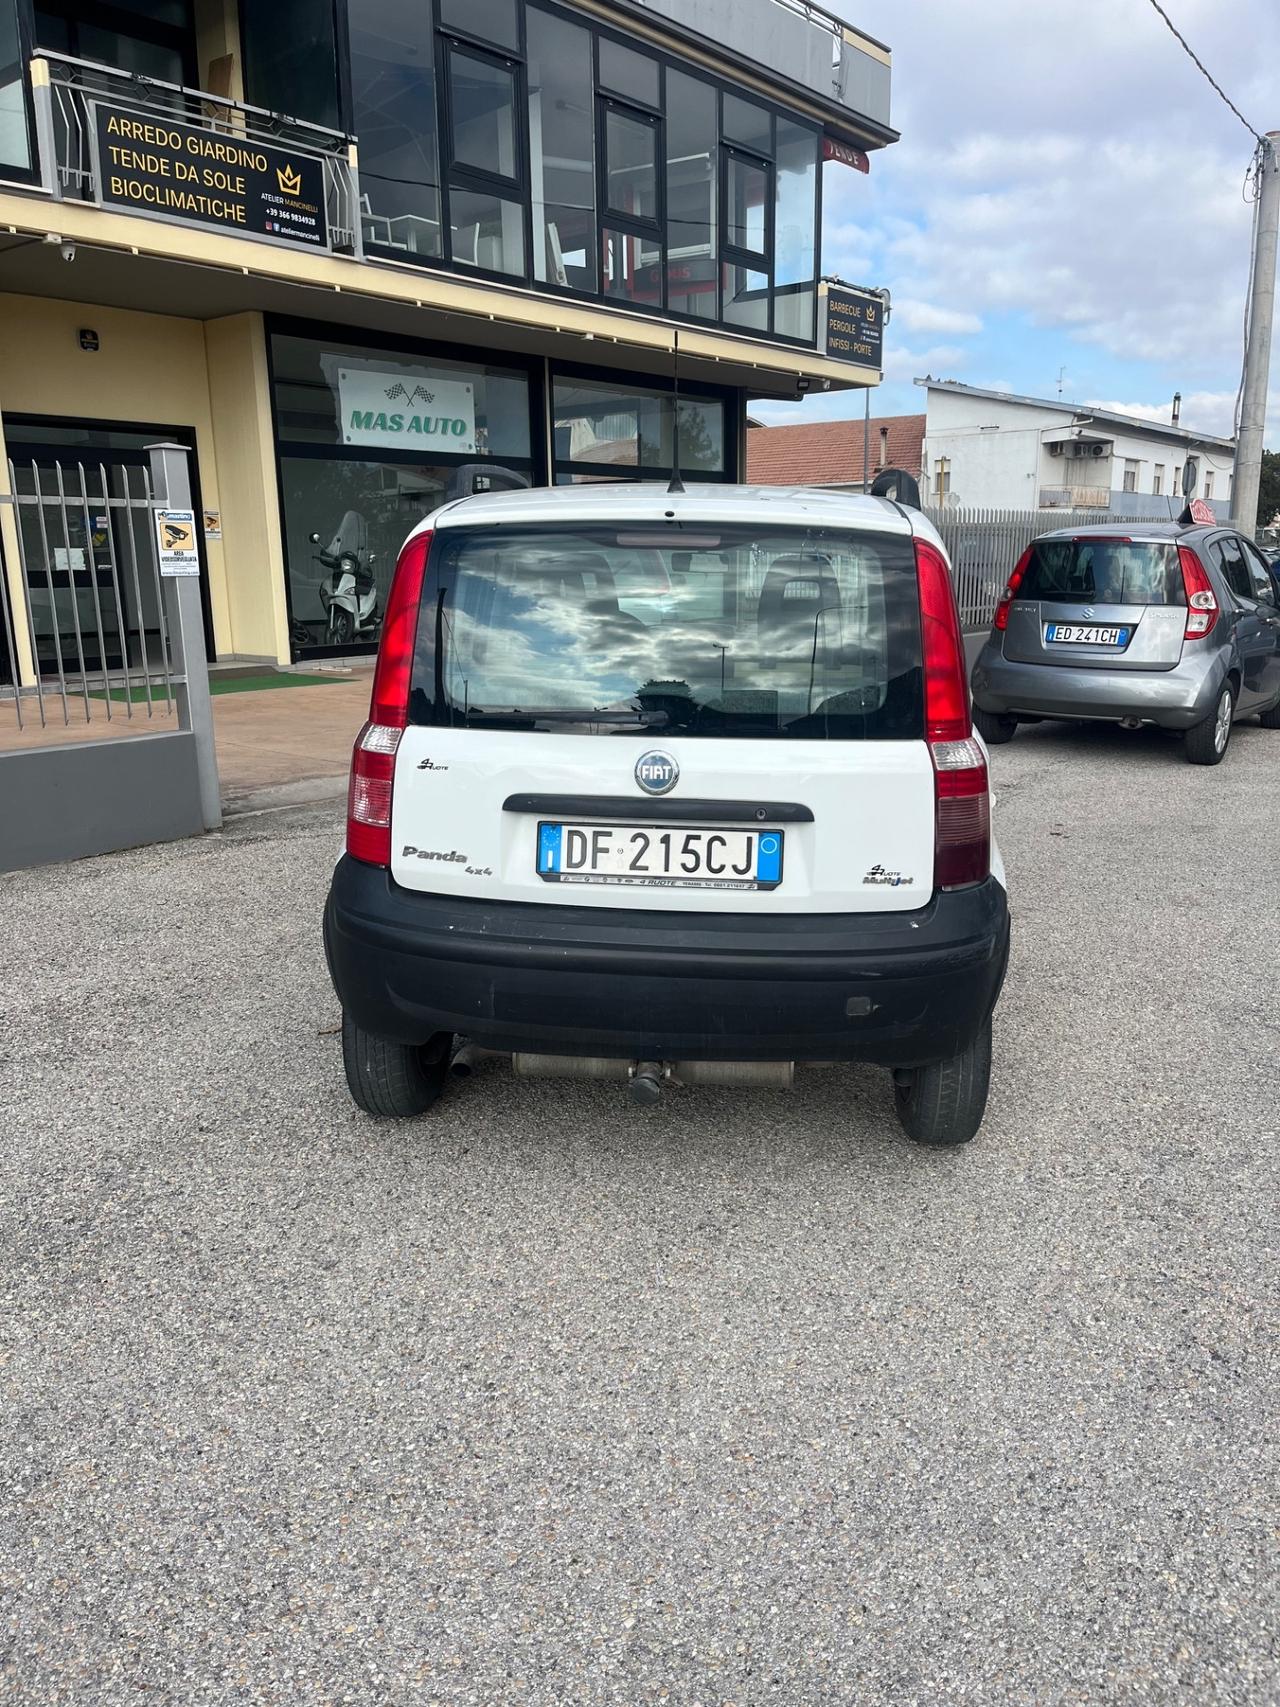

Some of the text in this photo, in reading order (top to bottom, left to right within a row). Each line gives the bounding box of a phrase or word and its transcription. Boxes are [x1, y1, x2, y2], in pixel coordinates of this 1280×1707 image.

[107, 116, 268, 172] ARREDO GIARDINO
[108, 146, 246, 195] TENDE DA SOLE
[110, 176, 247, 223] BIOCLIMATICHE
[261, 193, 284, 204] ATELIER
[266, 208, 278, 217] +39
[830, 300, 861, 318] BARBECUE
[829, 319, 856, 335] PERGOLE
[854, 342, 872, 357] PORTE
[350, 410, 467, 437] MAS AUTO
[1055, 625, 1072, 640] ED
[1075, 628, 1119, 643] 241CH
[641, 765, 672, 780] FIAT
[402, 845, 468, 864] Panda
[566, 829, 613, 870] DF
[629, 832, 753, 876] 215CJ
[464, 866, 493, 876] 4x4
[648, 879, 677, 887] RUOTE
